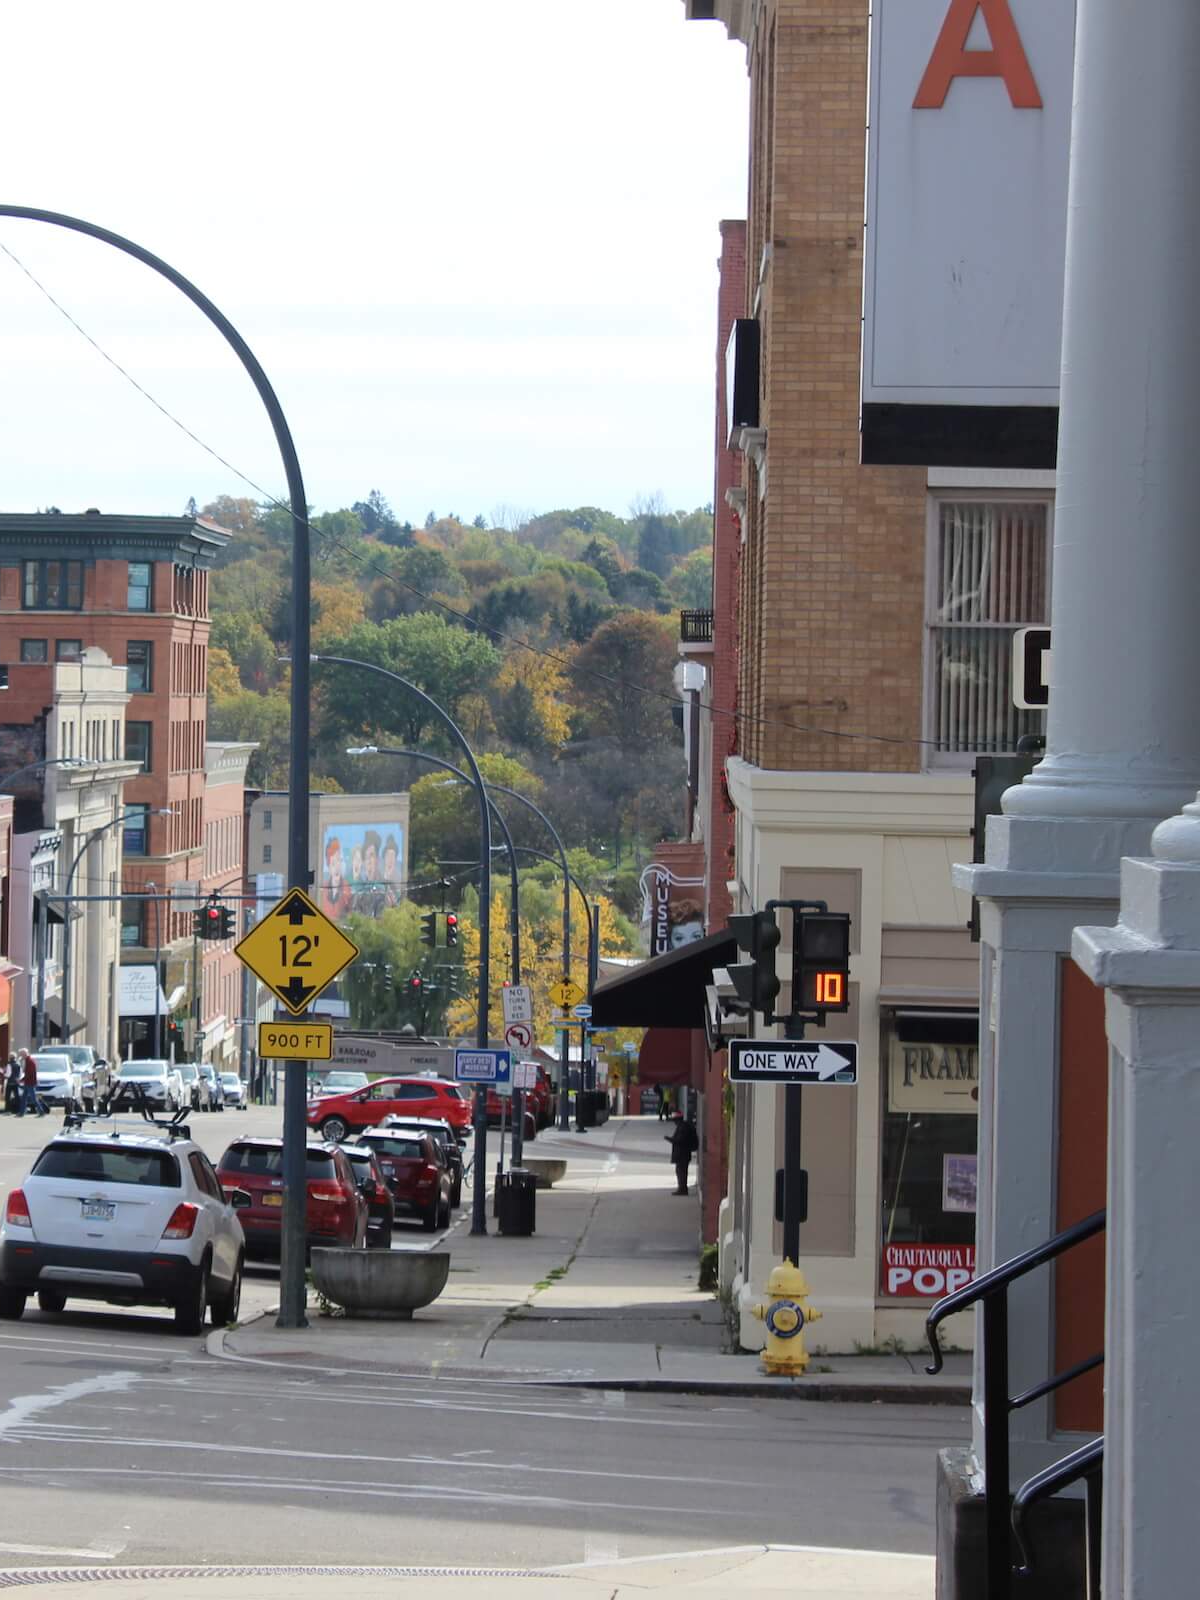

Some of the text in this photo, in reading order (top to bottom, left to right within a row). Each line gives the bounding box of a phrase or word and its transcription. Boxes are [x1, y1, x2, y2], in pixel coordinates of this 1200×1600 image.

[655, 872, 671, 955] MUSEU
[279, 935, 320, 967] 12'
[816, 973, 842, 1002] 10
[267, 1033, 324, 1049] 900 FT
[743, 1052, 818, 1070] ONE WAY
[902, 1046, 976, 1087] FRAM
[886, 1247, 962, 1268] CHAUTAUQUA
[888, 1267, 976, 1294] POP
